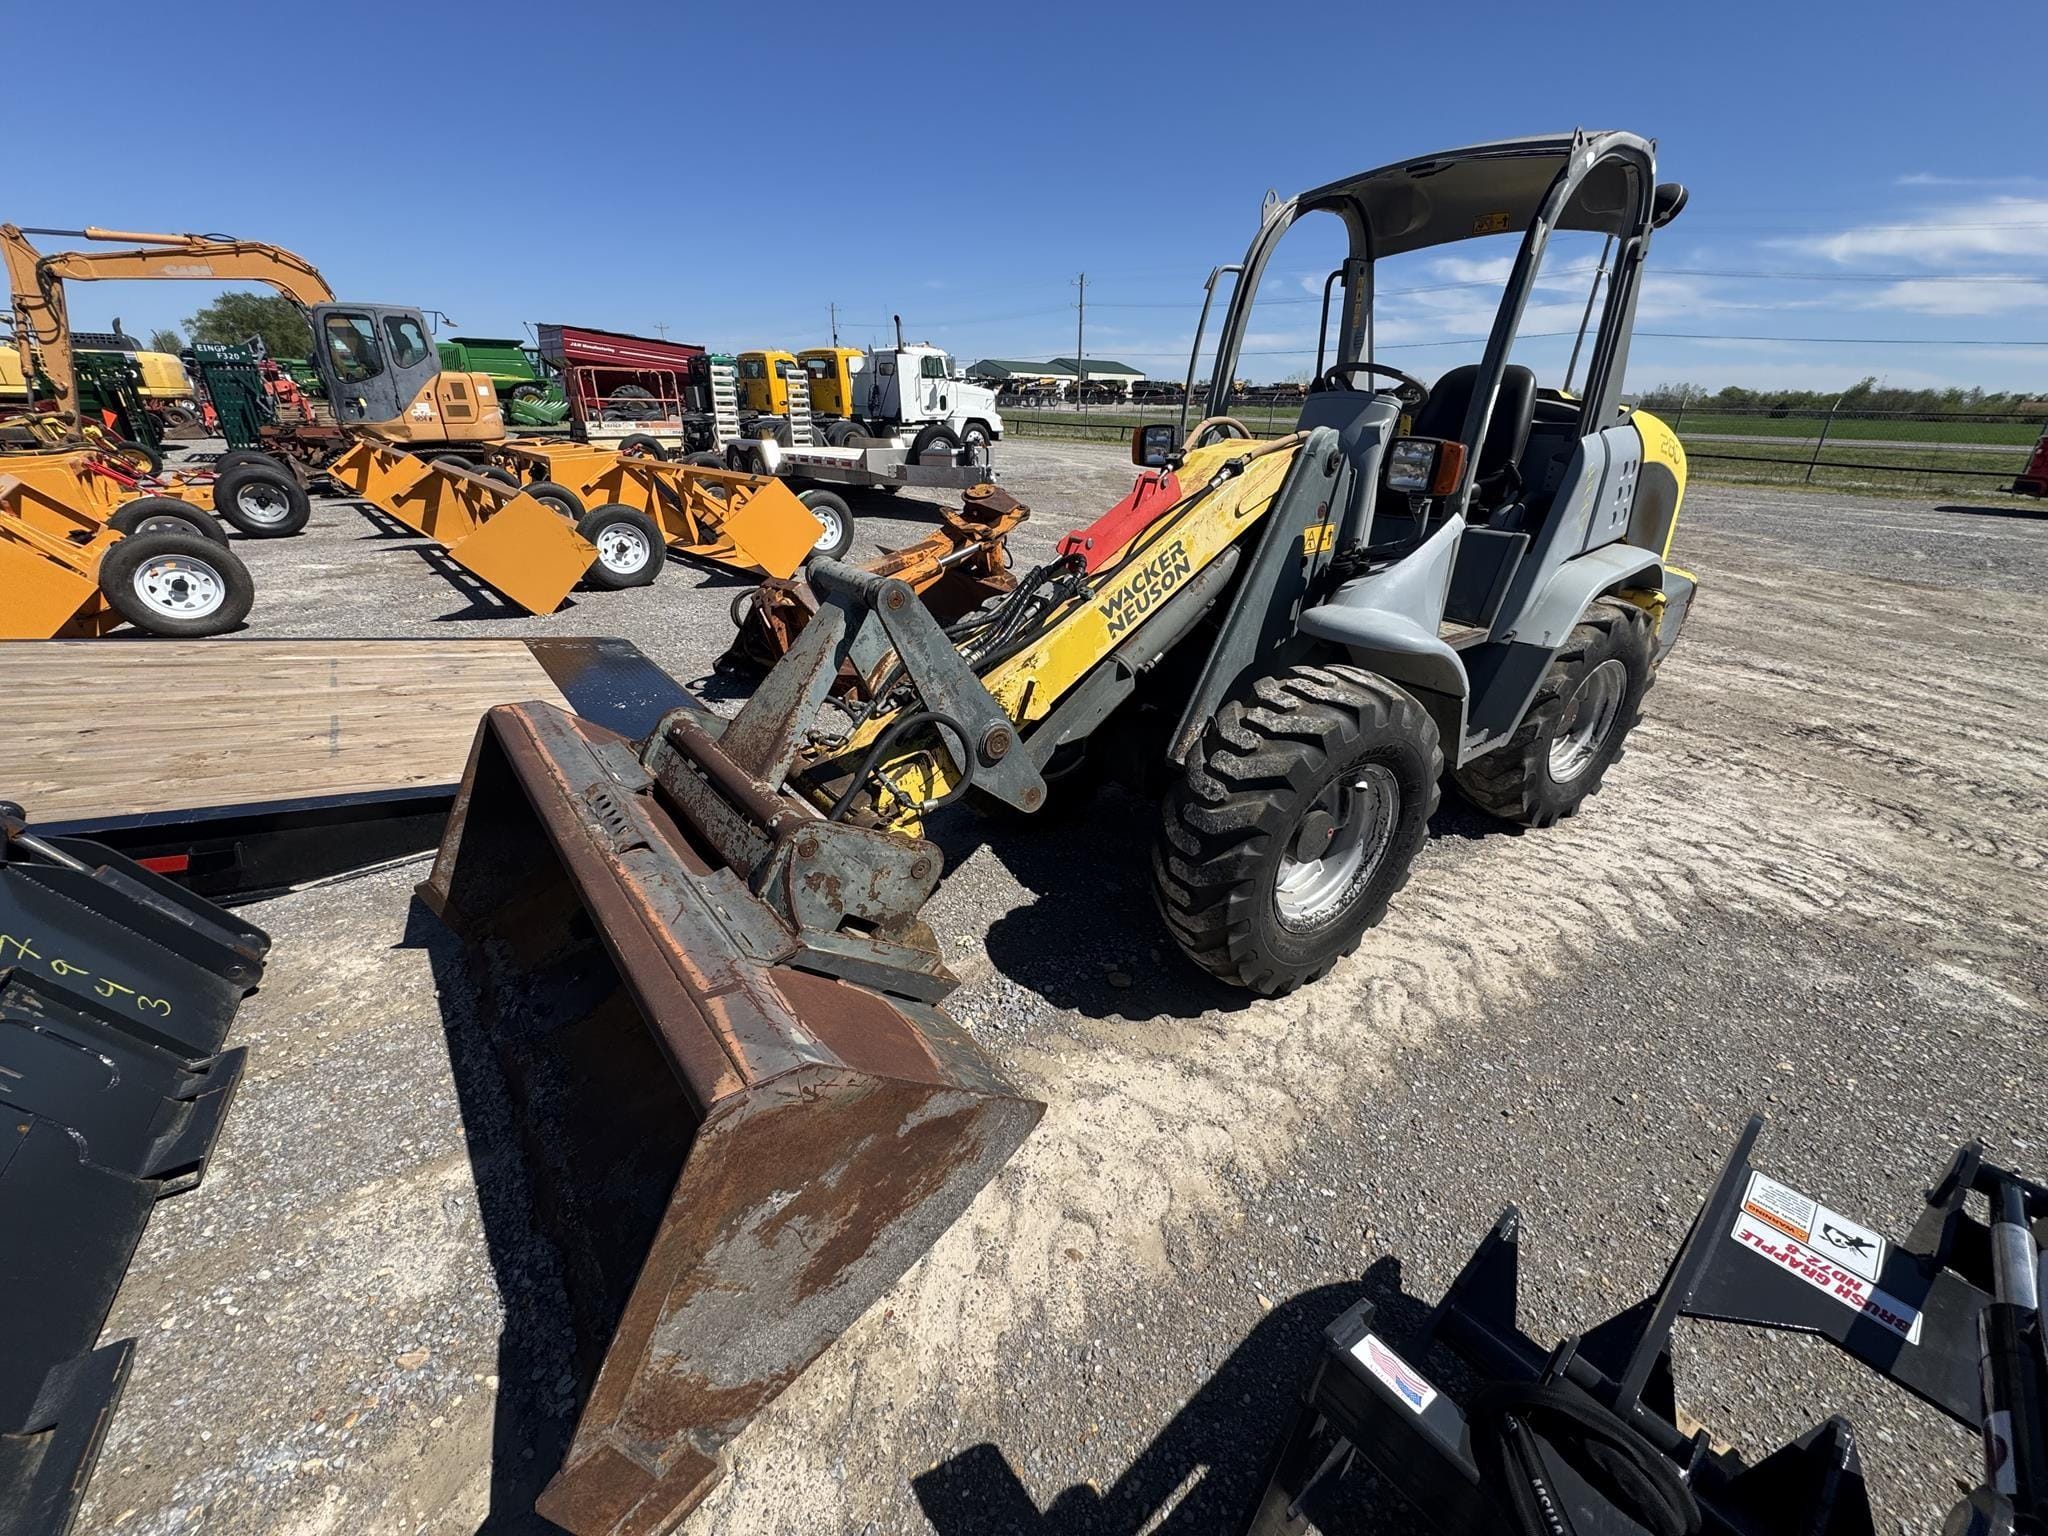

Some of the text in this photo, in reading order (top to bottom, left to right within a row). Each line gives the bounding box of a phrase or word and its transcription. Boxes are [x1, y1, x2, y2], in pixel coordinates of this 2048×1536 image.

[216, 352, 240, 360] F320
[1098, 539, 1186, 619] WACKER
[1107, 555, 1191, 640] NEUSON
[1748, 1204, 1796, 1234] WARNING
[1737, 1228, 1912, 1334] BRUSH GRAPPLE
[1785, 1243, 1863, 1291] HD72-8
